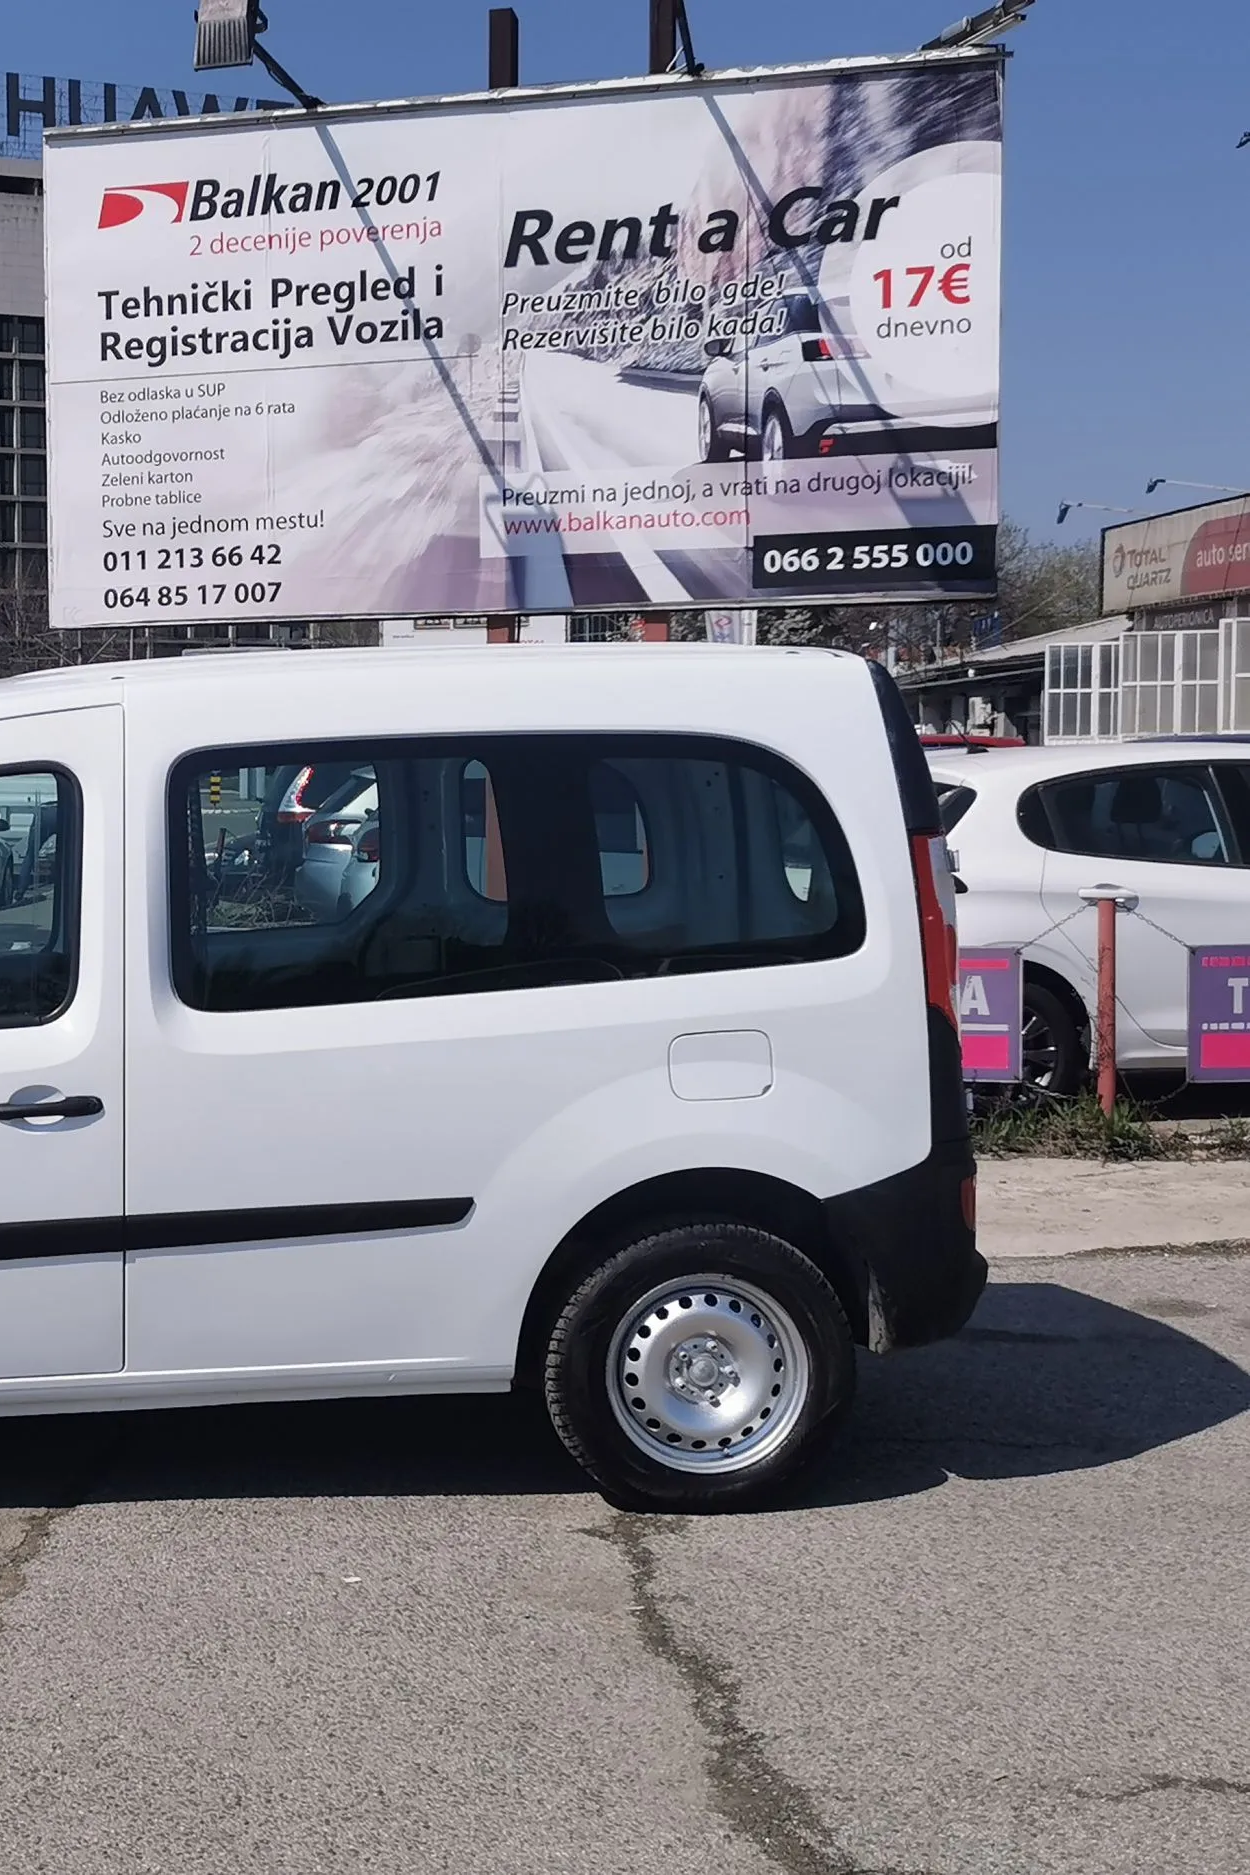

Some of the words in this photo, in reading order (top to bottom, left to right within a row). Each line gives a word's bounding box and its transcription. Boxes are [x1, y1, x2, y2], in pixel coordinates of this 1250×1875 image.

[6, 73, 294, 136] HUA
[189, 172, 340, 222] Balkan
[351, 171, 441, 207] 2001
[189, 235, 203, 256] 2
[210, 227, 312, 255] decenije
[320, 217, 442, 251] poverenja
[503, 202, 678, 268] Rent
[697, 209, 738, 253] a
[767, 186, 901, 246] Car
[940, 236, 972, 260] od
[98, 278, 252, 320] Tehnički
[271, 265, 416, 313] Pregled
[434, 264, 444, 296] i
[502, 284, 638, 316] Preuzmite
[656, 279, 705, 305] bilo
[722, 272, 785, 308] gde!
[873, 263, 971, 310] 17€
[100, 318, 313, 368] Registracija
[327, 309, 444, 347] Vozila
[502, 318, 644, 351] Rezervišite
[650, 316, 700, 342] bilo
[707, 309, 786, 338] kada!
[876, 315, 972, 339] dnevno
[100, 389, 124, 403] Bez
[128, 386, 181, 401] odlaska
[185, 388, 194, 399] u
[198, 383, 226, 398] SUP
[100, 407, 168, 425] Odloženo
[172, 404, 230, 423] plaćanje
[234, 405, 251, 417] na
[255, 402, 264, 415] 6
[267, 401, 296, 415] rata
[101, 432, 141, 445] Kasko
[102, 448, 225, 467] Autoodgovornost
[102, 473, 143, 487] Zeleni
[148, 471, 193, 484] karton
[503, 485, 586, 508] Preuzmi
[592, 486, 617, 503] na
[620, 478, 696, 506] jednoj,
[702, 483, 713, 498] a
[719, 477, 768, 497] vrati
[775, 477, 801, 495] na
[807, 467, 882, 498] drugoj
[888, 461, 974, 490] lokaciji!
[102, 494, 150, 508] Probne
[155, 490, 201, 505] tablice
[102, 519, 135, 538] Sve
[142, 522, 165, 536] na
[170, 515, 249, 540] jednom
[255, 510, 325, 531] mestu!
[503, 505, 750, 535] www.balkanauto.com
[103, 551, 147, 571] 011
[157, 548, 203, 569] 213
[212, 546, 243, 566] 66
[250, 544, 282, 565] 42
[763, 548, 819, 573] 066
[826, 546, 844, 570] 2
[853, 544, 909, 569] 555
[916, 541, 973, 566] 000
[1127, 547, 1166, 568] TOTAL
[1196, 544, 1225, 568] auto
[1127, 567, 1171, 590] QUARTZ
[103, 588, 150, 608] 064
[157, 586, 188, 606] 85
[198, 584, 225, 605] 17
[235, 582, 282, 603] 007
